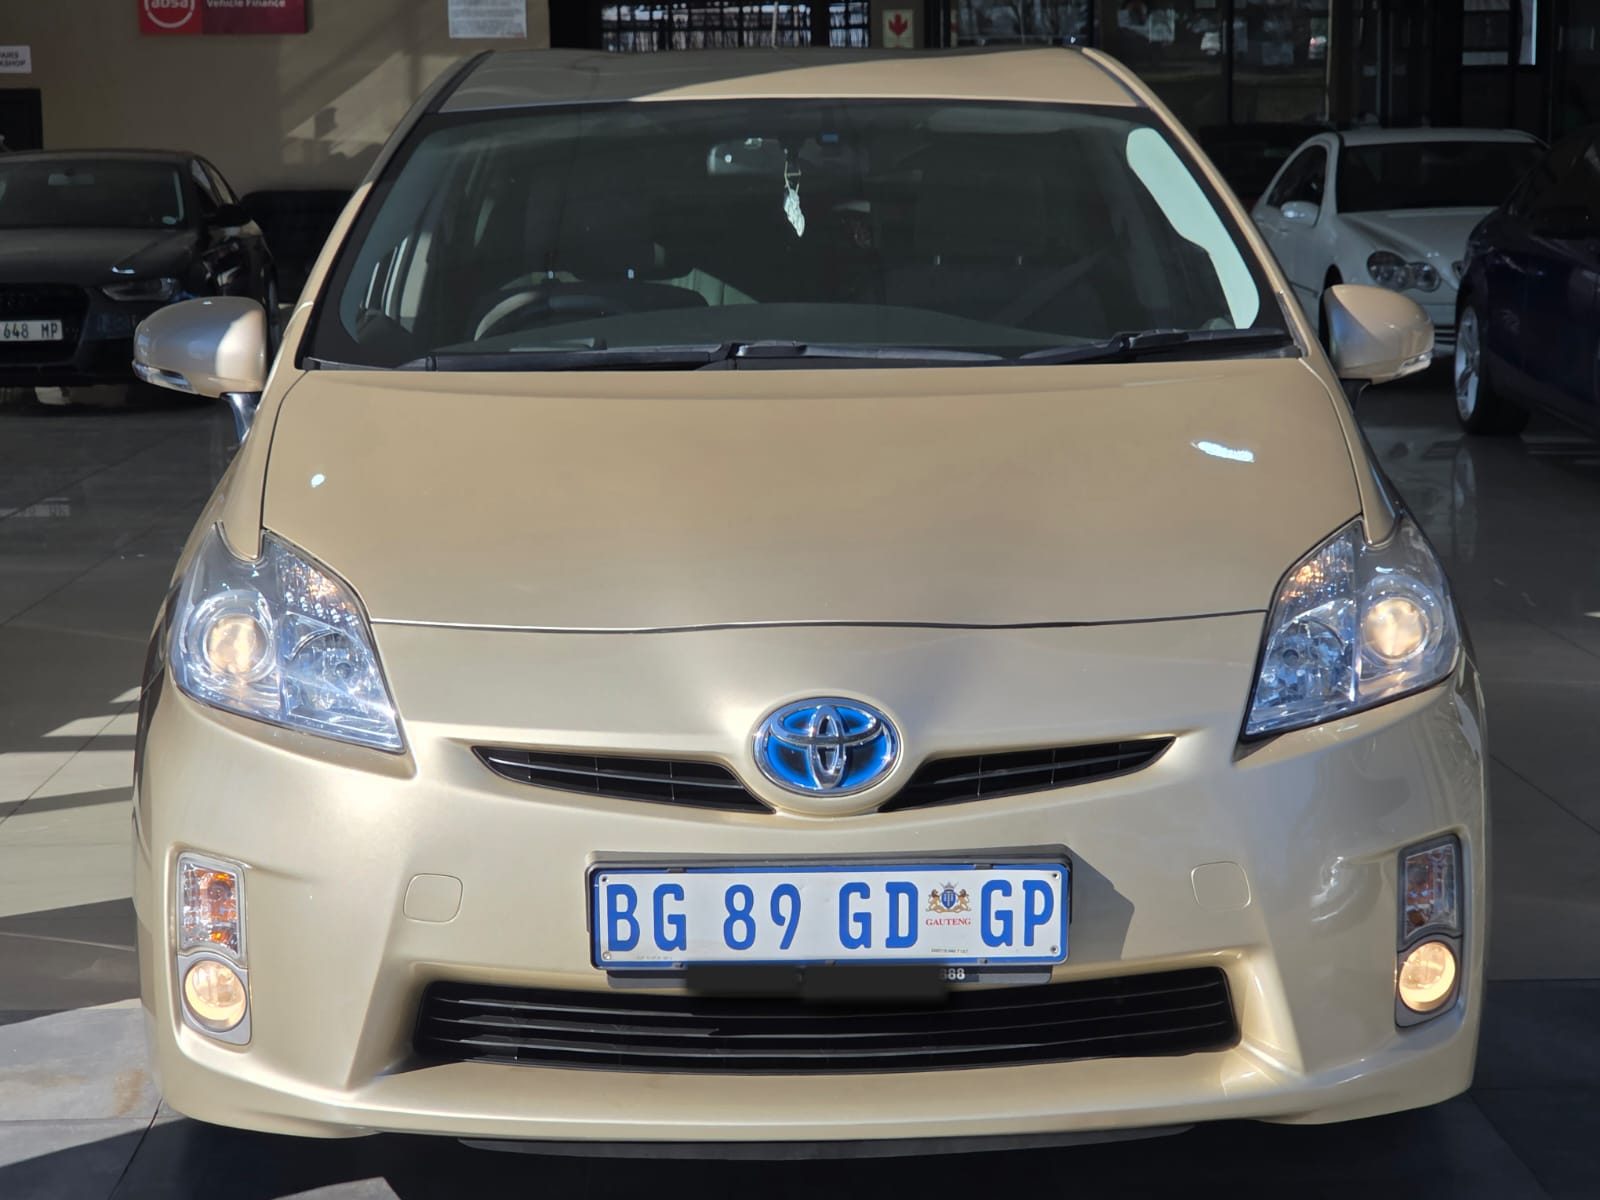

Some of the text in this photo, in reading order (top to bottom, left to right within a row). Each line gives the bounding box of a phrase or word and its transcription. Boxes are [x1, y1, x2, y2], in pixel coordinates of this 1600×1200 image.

[206, 0, 286, 8] Vehicle Finance
[3, 322, 58, 339] 648 MP
[606, 879, 1055, 951] BG 89 GD GP
[925, 917, 972, 926] GAUTENG
